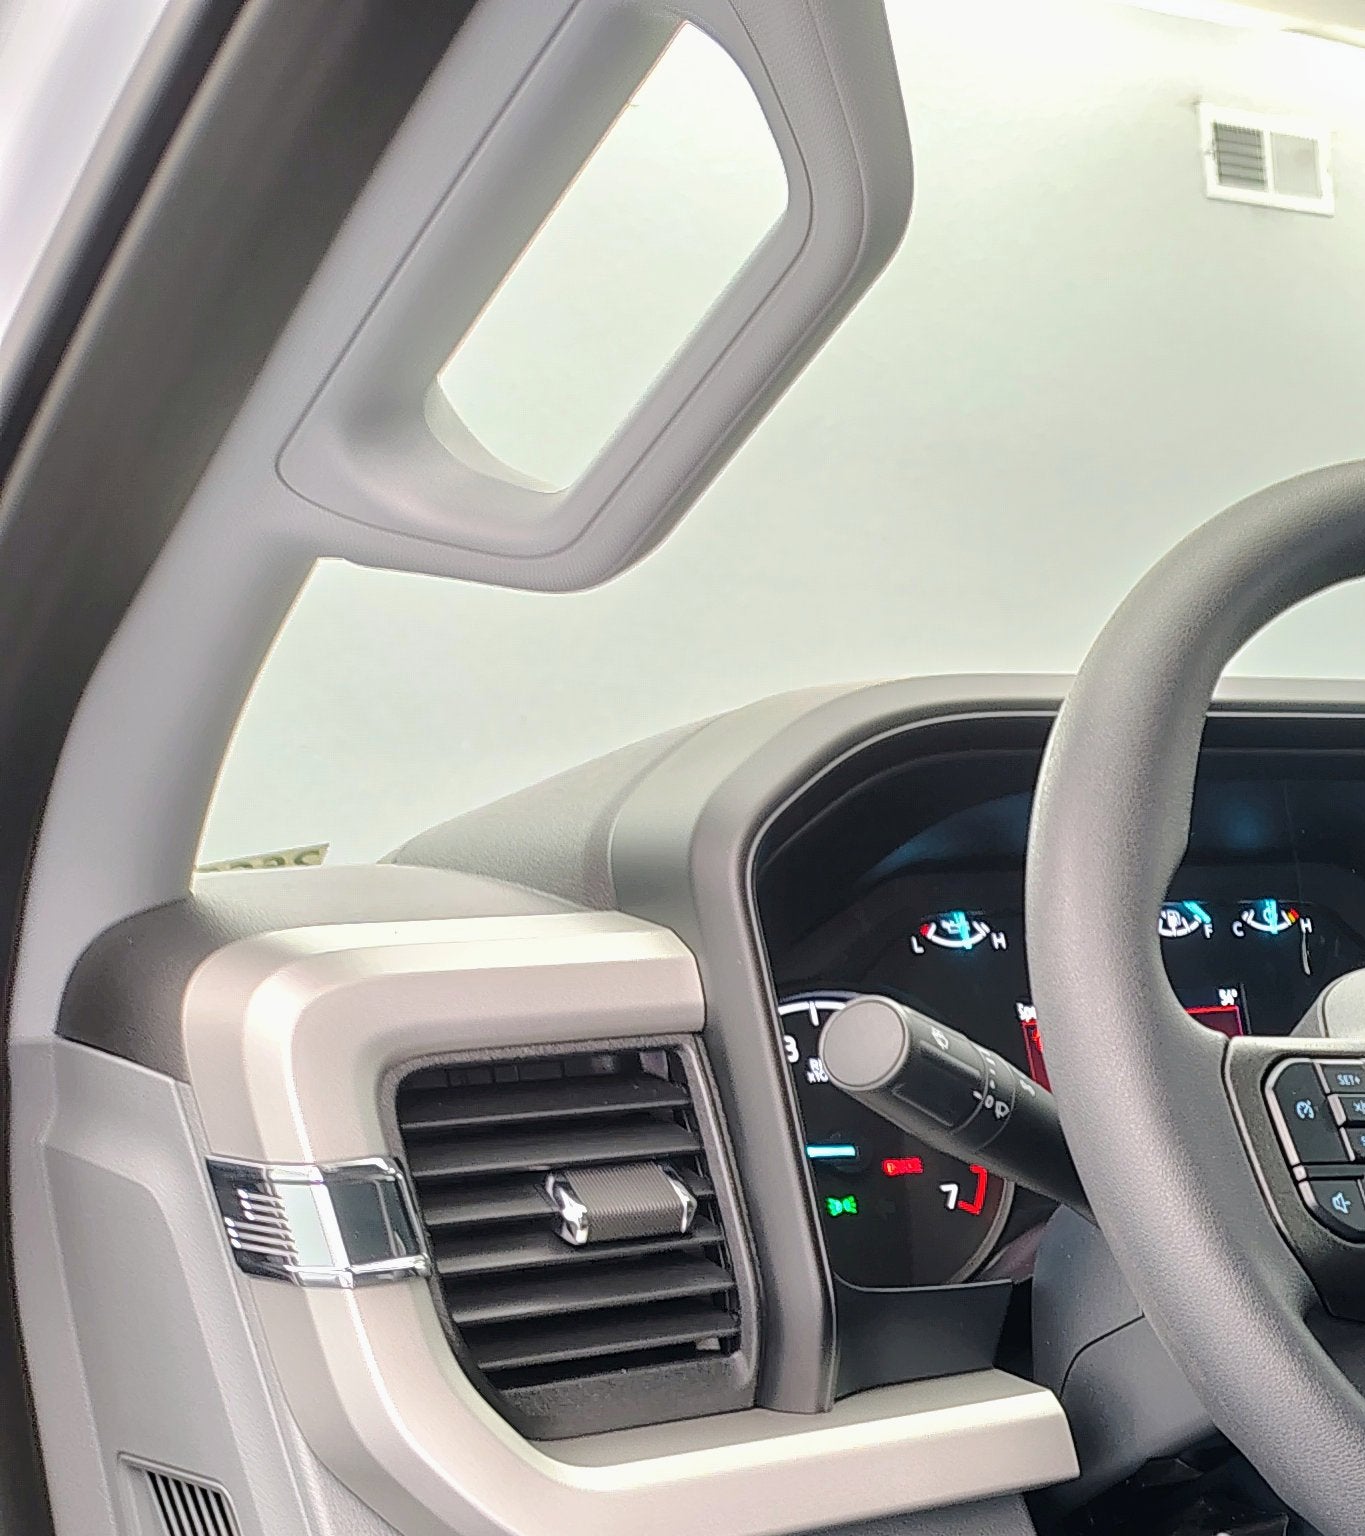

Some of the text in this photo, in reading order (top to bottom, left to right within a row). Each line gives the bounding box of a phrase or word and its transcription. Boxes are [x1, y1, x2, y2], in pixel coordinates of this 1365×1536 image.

[1204, 924, 1214, 938] F
[1232, 921, 1245, 937] C
[1300, 918, 1313, 934] H
[991, 931, 1007, 950] H
[939, 1183, 959, 1210] 7
